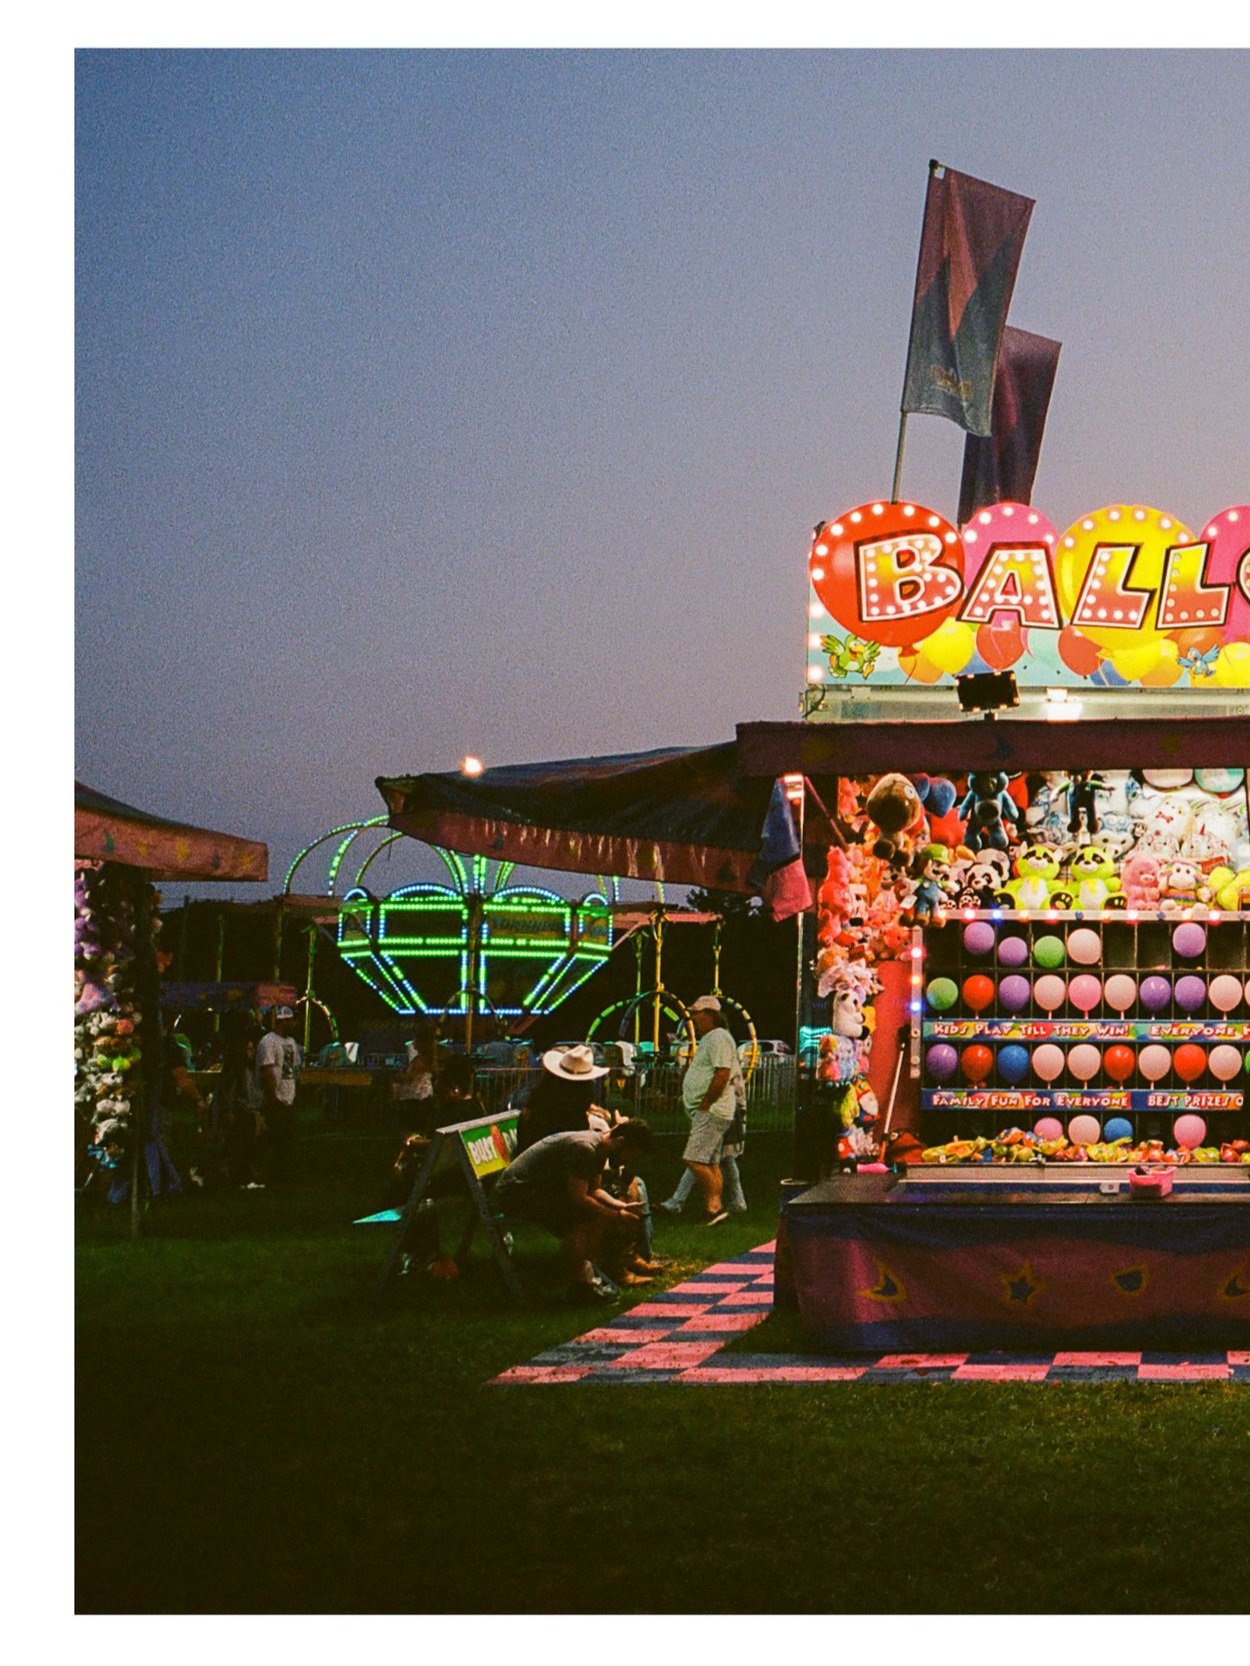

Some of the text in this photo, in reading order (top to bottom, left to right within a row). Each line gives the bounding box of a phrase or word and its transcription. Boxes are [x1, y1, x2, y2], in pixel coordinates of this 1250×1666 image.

[933, 1024, 968, 1035] KIDS
[976, 1024, 1011, 1035] PLAY
[1053, 1025, 1090, 1036] THEY
[1097, 1025, 1129, 1036] WIN!
[1150, 1025, 1235, 1036] EVERYONE
[932, 1094, 1128, 1107] FAMILY FUN FOR EVERYONE
[1147, 1095, 1179, 1107] BEST
[1183, 1095, 1229, 1107] PRIZES
[466, 1134, 498, 1166] BUST
